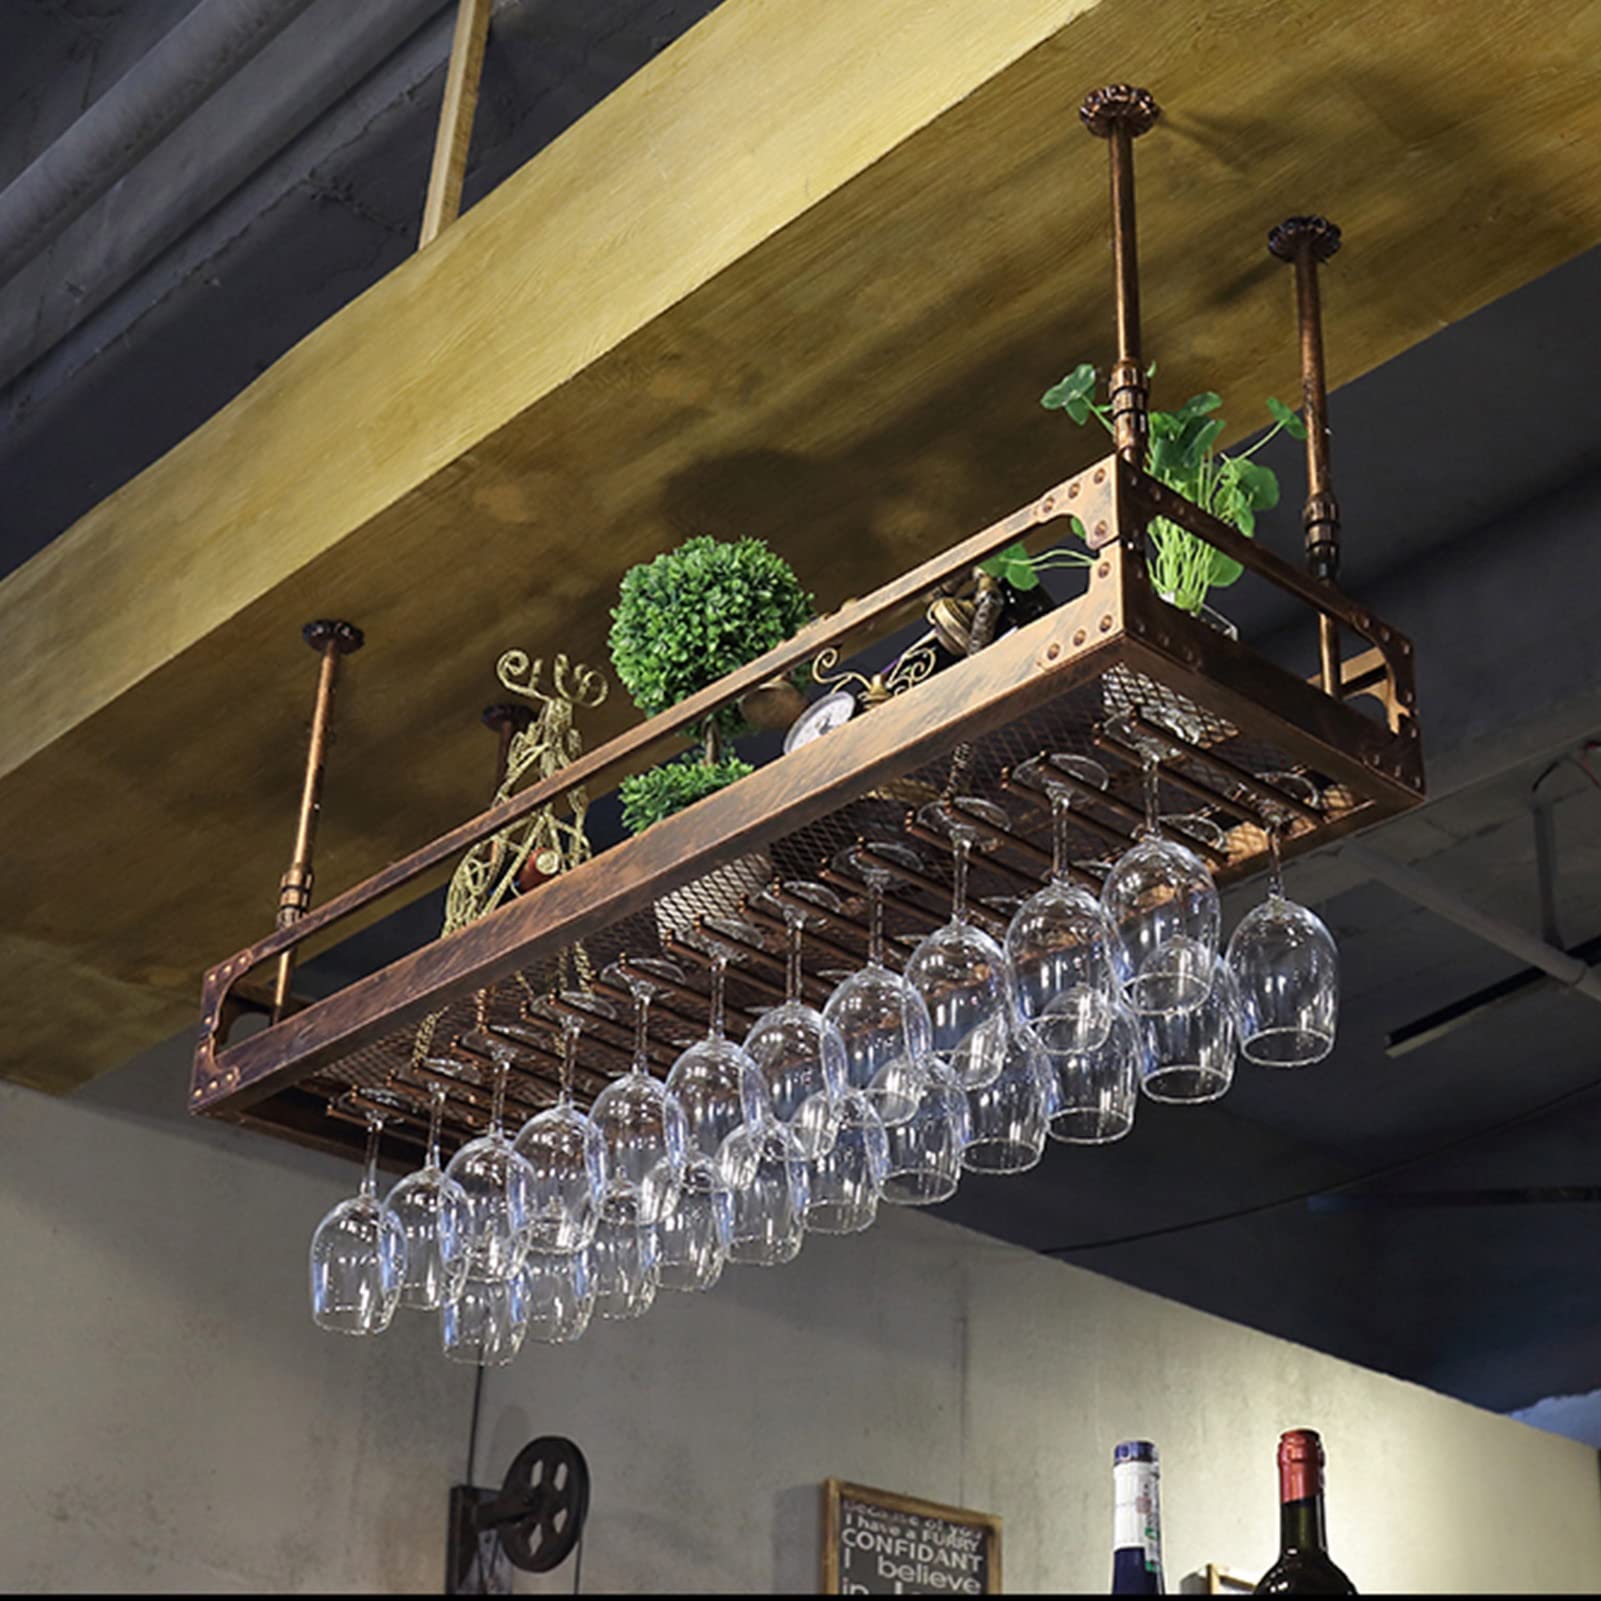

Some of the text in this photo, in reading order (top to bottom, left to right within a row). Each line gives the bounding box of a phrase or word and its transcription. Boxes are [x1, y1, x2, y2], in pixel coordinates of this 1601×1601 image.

[846, 1513, 852, 1525] I
[857, 1514, 901, 1537] have
[905, 1530, 918, 1540] a
[842, 1528, 984, 1572] CONFIDANT
[844, 1548, 851, 1569] I
[878, 1556, 983, 1595] believe
